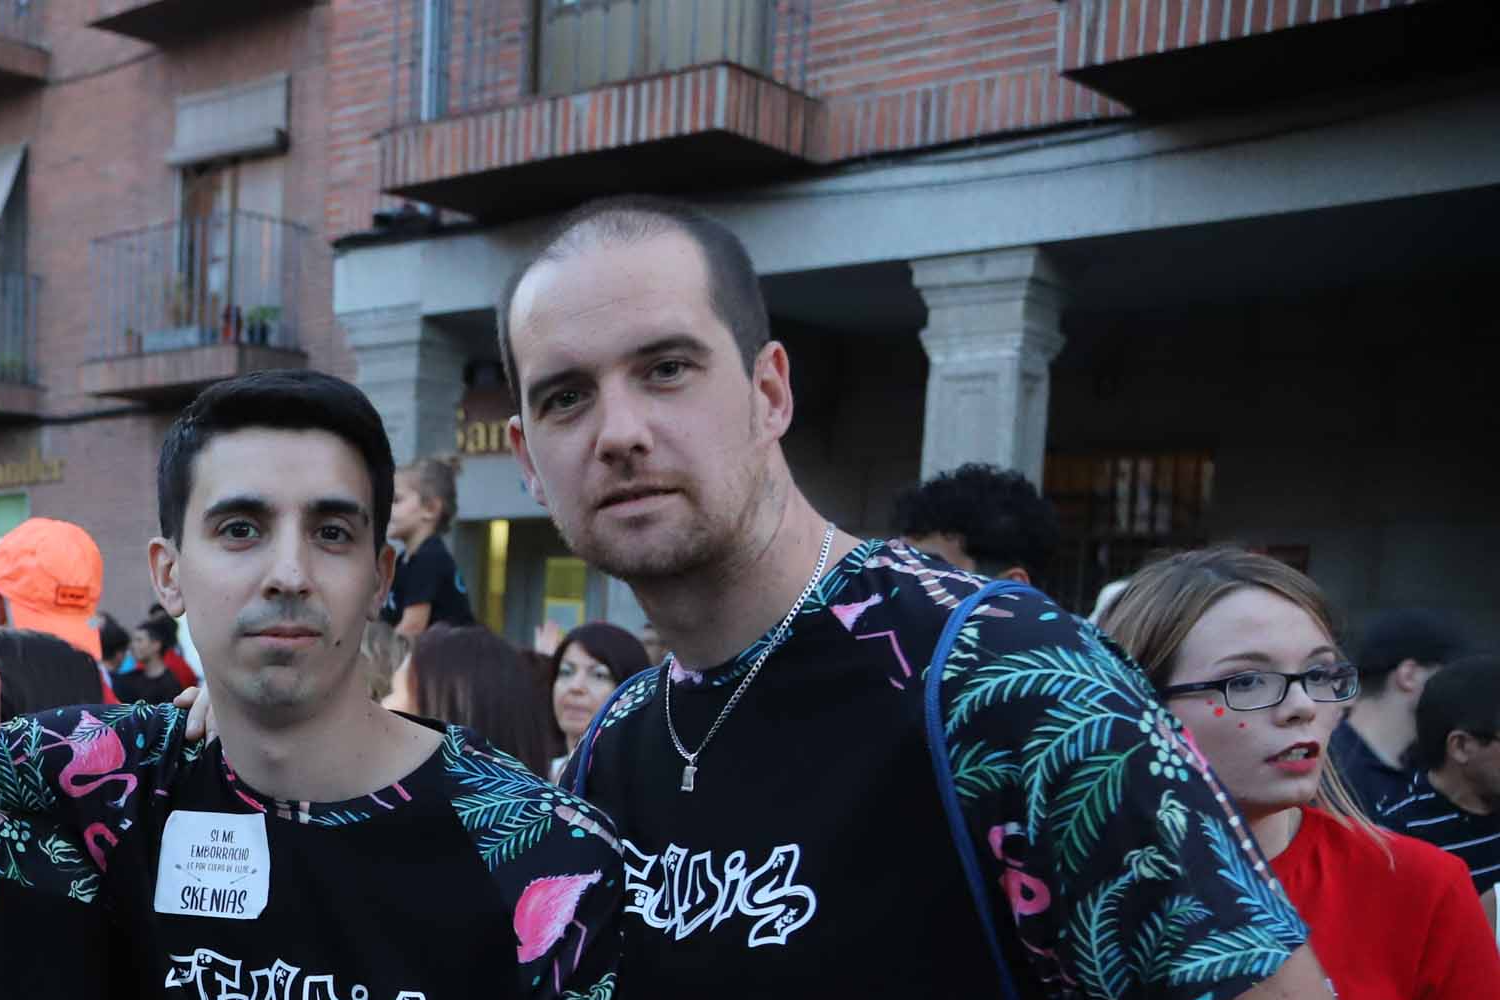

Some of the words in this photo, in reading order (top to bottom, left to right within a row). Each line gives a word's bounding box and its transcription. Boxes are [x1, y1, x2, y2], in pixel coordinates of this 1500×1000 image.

[210, 829, 219, 842] SI
[221, 829, 235, 843] ME
[190, 844, 250, 861] EMBORRACHO
[180, 885, 247, 914] SKENIAS
